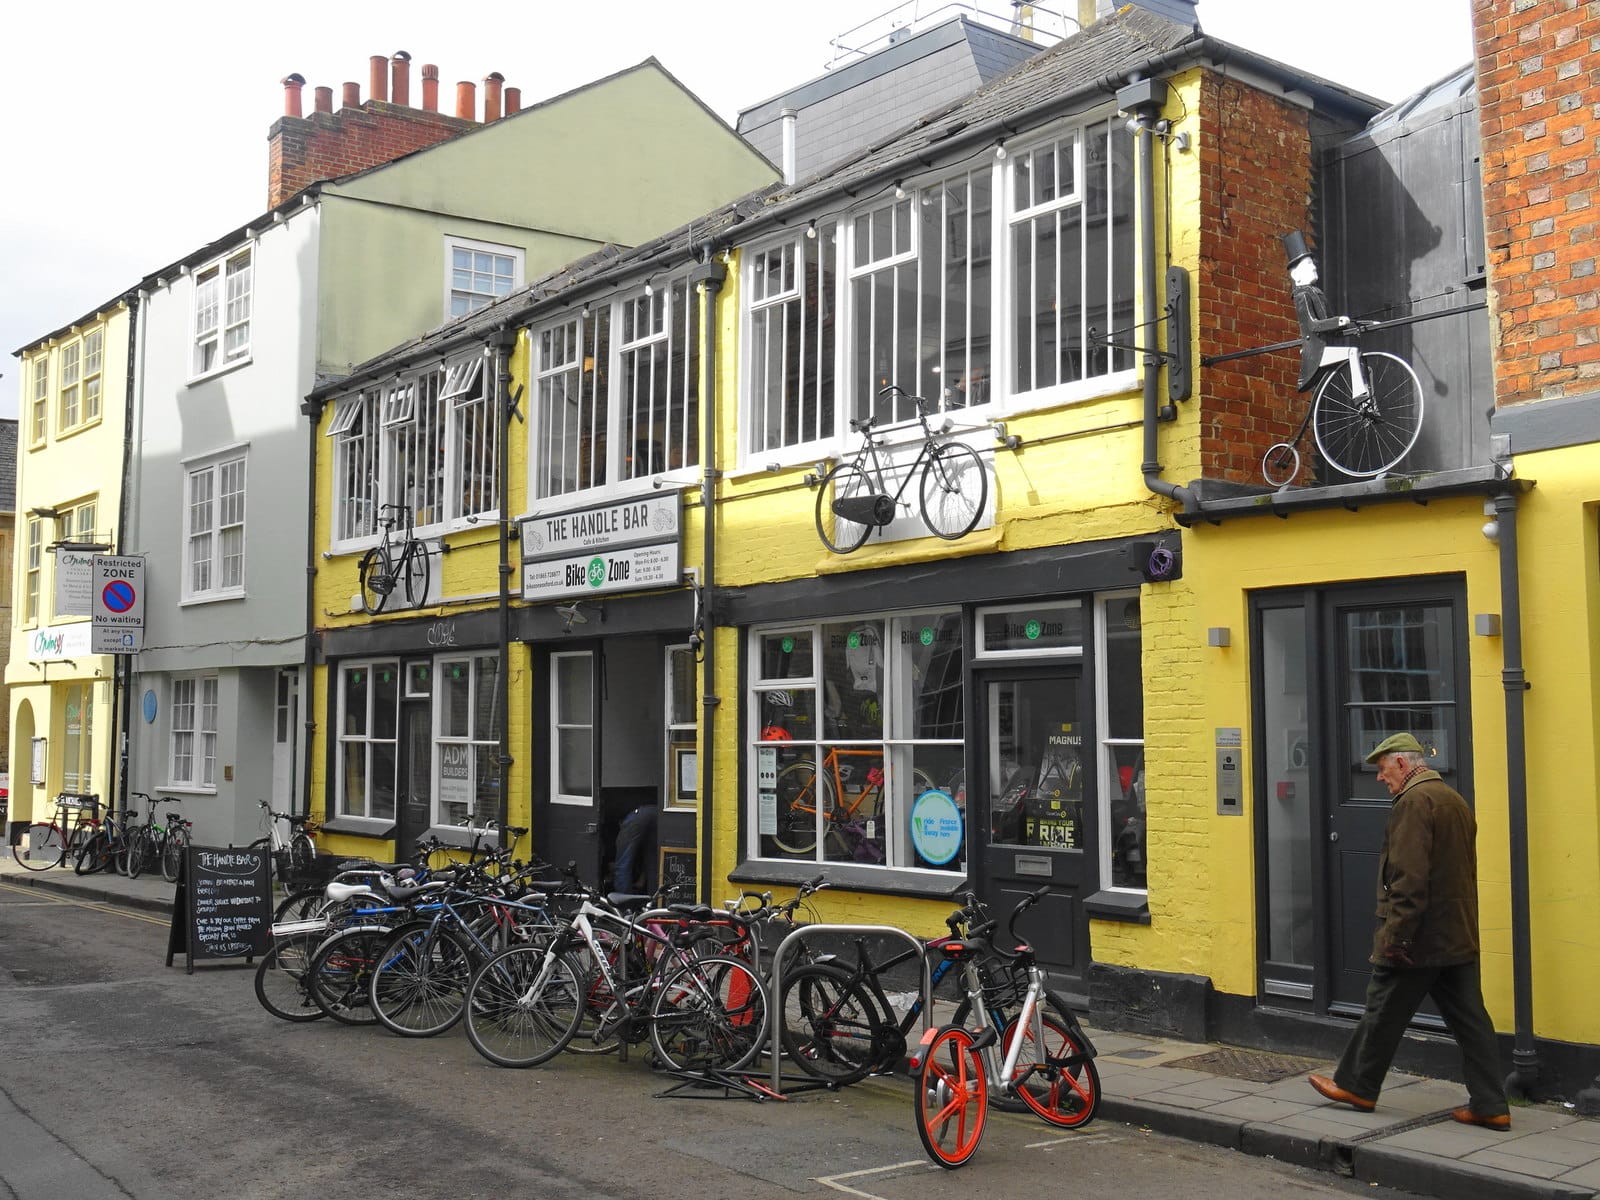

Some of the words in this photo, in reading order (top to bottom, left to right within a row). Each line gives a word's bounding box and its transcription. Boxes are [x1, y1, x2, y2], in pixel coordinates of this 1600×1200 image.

[546, 518, 568, 542] THE
[572, 509, 618, 538] HANDLE
[624, 504, 648, 530] BAR
[97, 558, 141, 568] Restricted
[103, 568, 135, 578] ZONE
[566, 564, 586, 587] Bike
[608, 558, 630, 582] Zone
[110, 615, 141, 624] waiting
[1004, 622, 1024, 638] Bike
[1041, 622, 1063, 636] Zone
[860, 633, 878, 647] Zone
[901, 630, 920, 645] Bike
[443, 746, 468, 765] ADM
[443, 766, 468, 776] BUILDERS
[1040, 825, 1074, 842] RIDE
[236, 854, 256, 866] BAR
